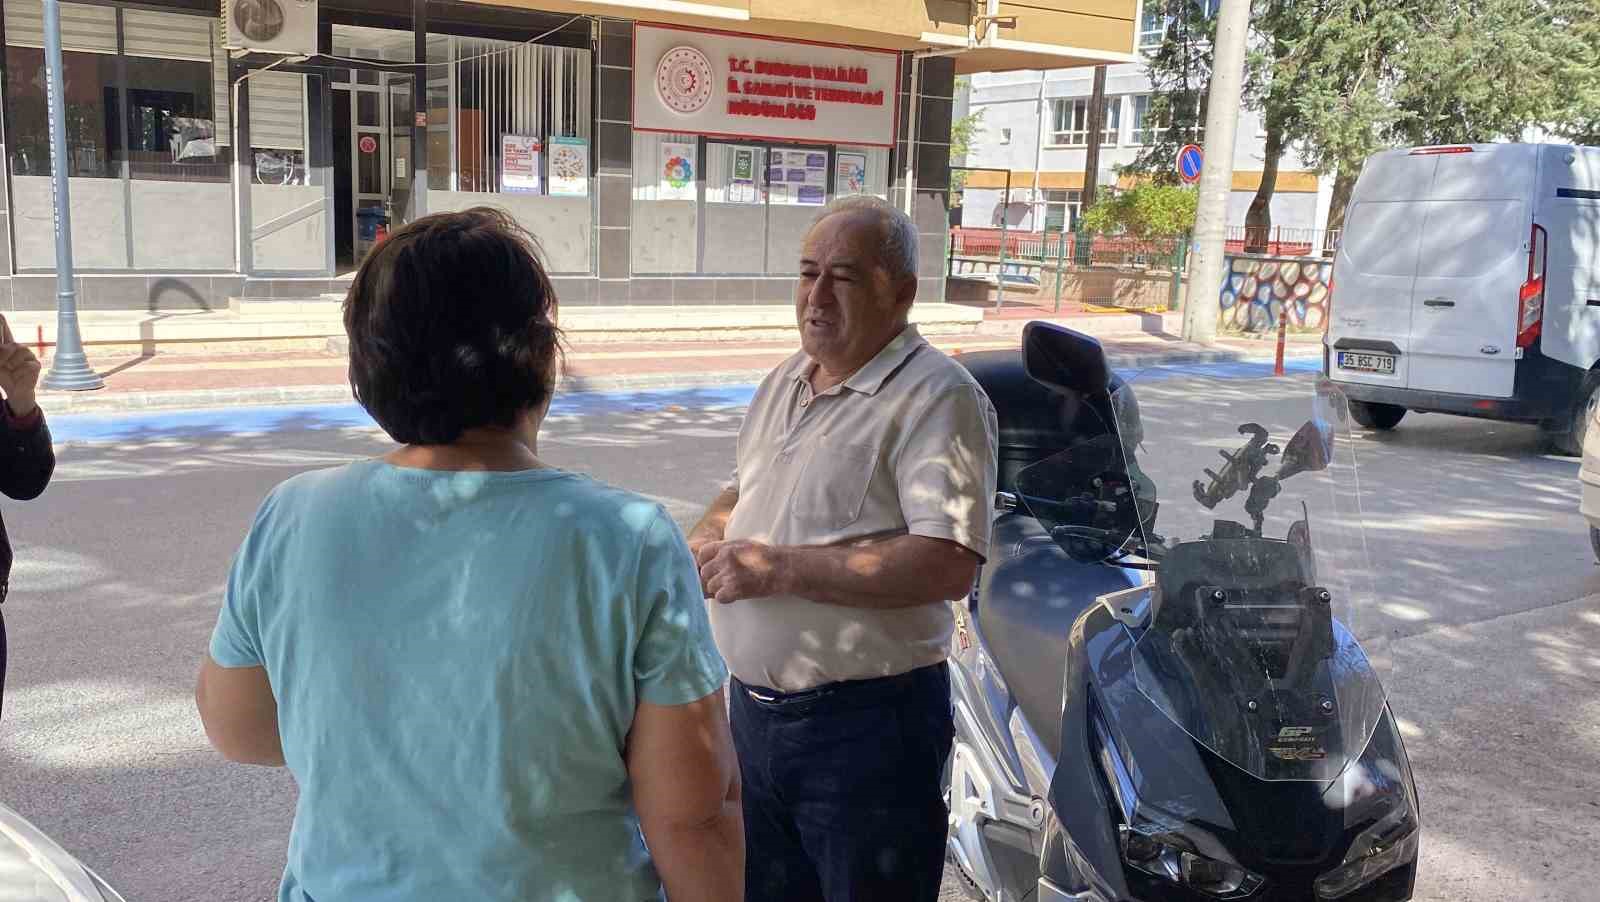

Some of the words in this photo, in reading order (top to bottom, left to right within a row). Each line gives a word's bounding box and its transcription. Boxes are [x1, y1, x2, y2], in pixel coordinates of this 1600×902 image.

[728, 55, 752, 73] T.C.
[1344, 353, 1354, 365] 35
[1358, 355, 1373, 367] BSC
[1376, 357, 1392, 369] 719
